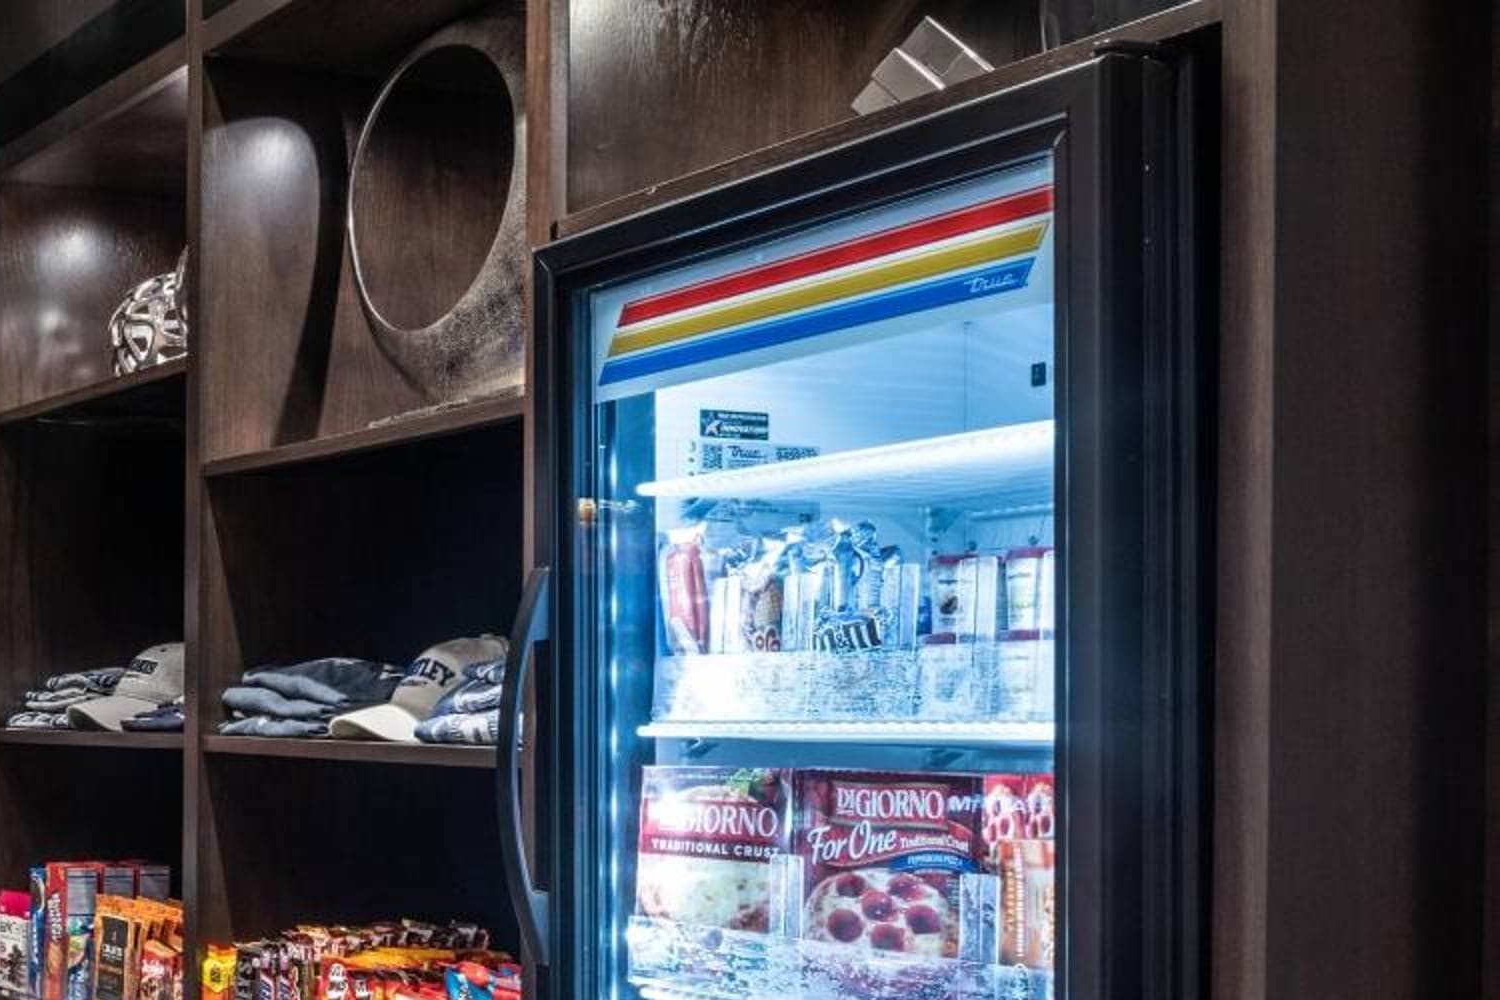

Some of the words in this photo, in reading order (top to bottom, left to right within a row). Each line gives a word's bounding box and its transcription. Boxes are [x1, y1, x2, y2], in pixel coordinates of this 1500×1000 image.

[651, 837, 730, 856] TRADITIONAL
[733, 844, 781, 858] CRUST
[807, 825, 847, 864] For
[850, 820, 898, 860] One
